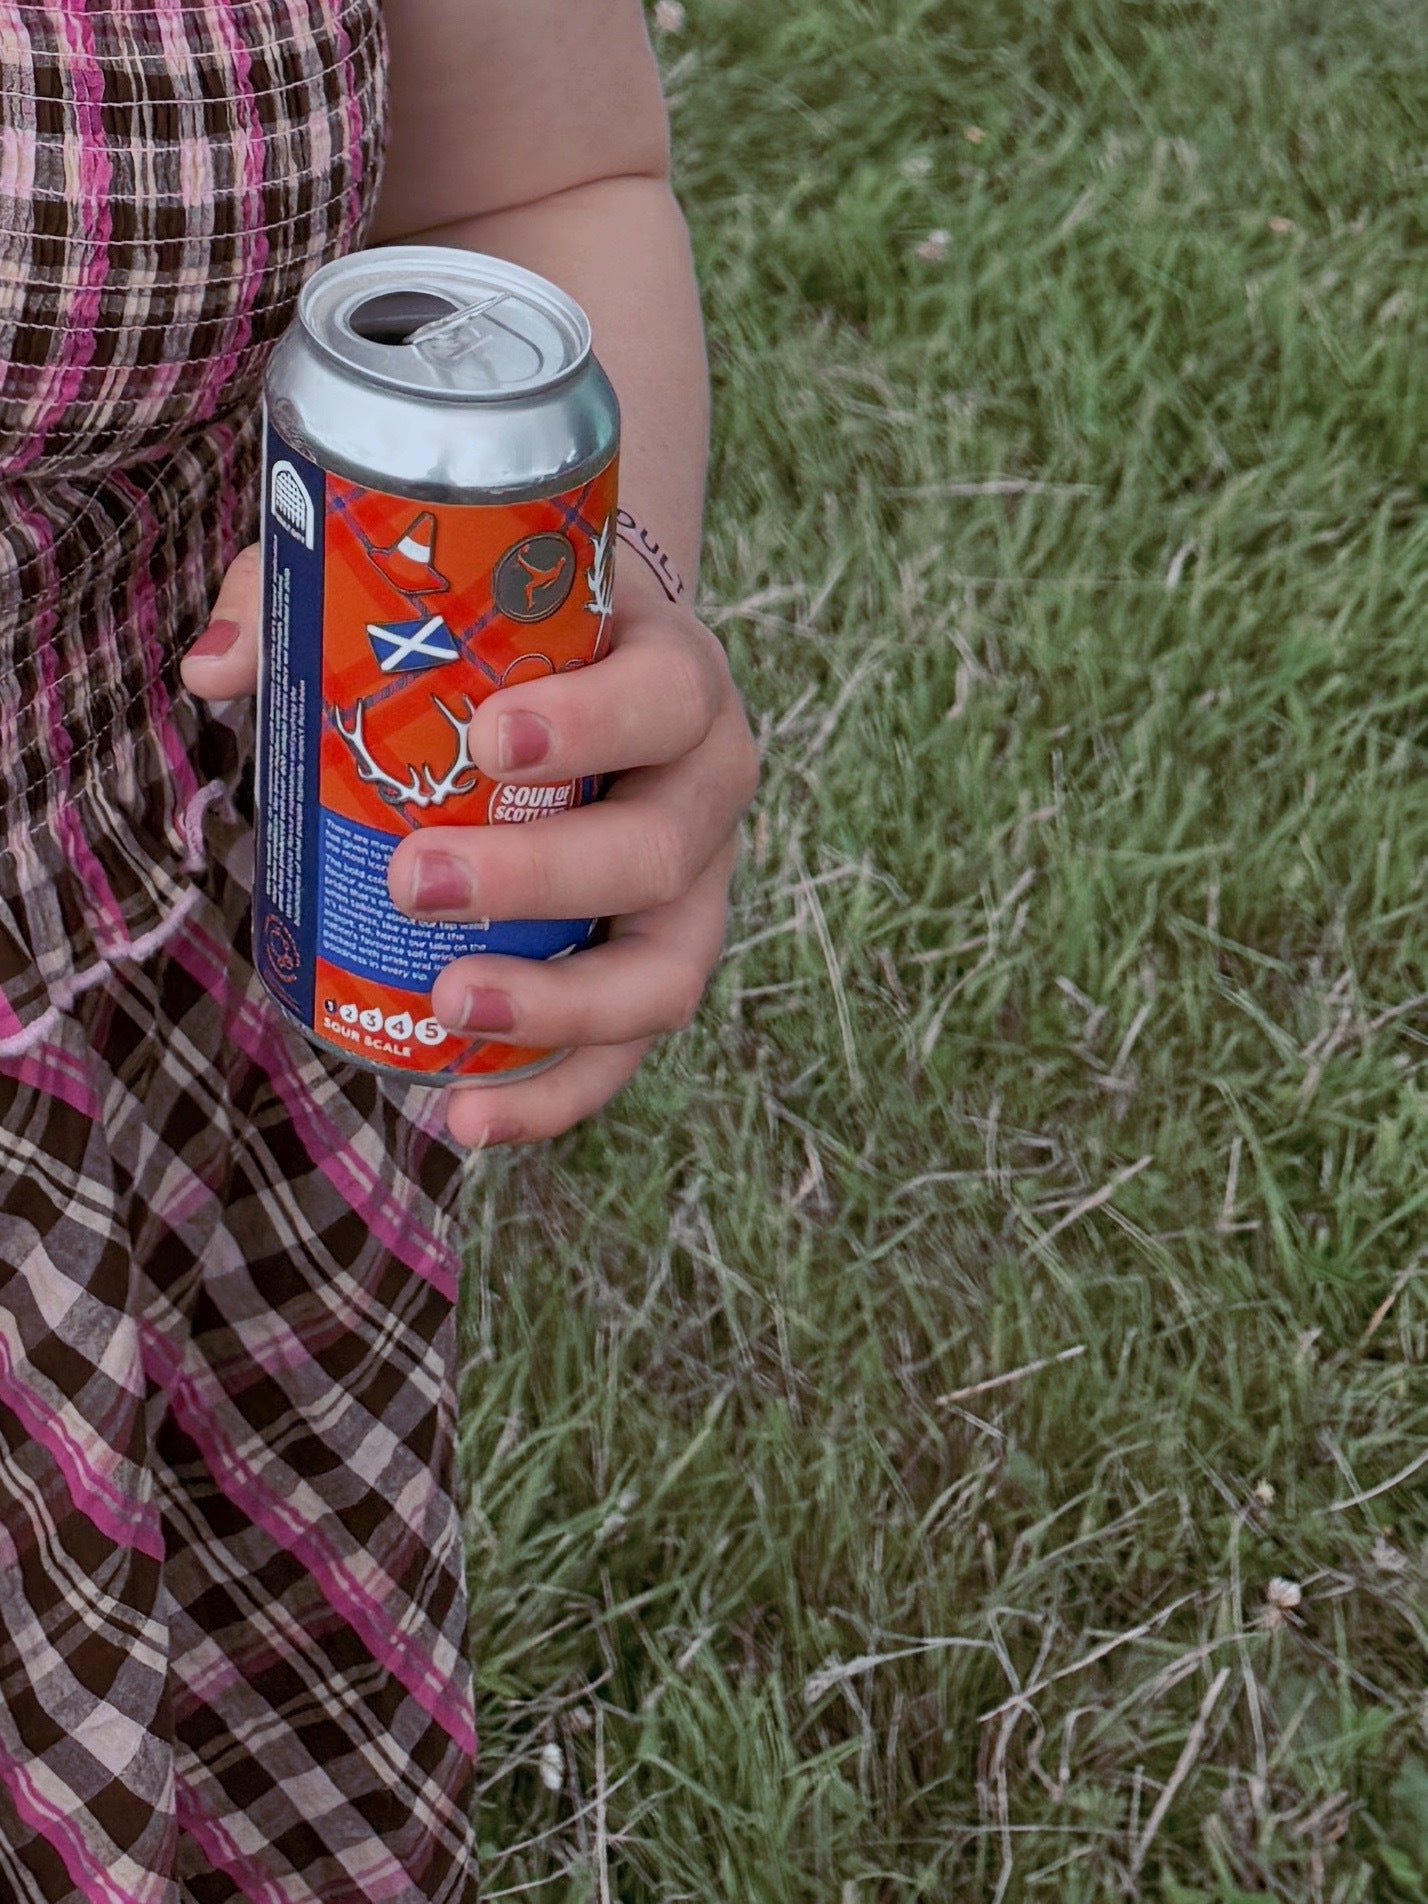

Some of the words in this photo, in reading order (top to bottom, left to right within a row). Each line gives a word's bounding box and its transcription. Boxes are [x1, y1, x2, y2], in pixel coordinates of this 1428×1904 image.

[500, 784, 556, 807] SOUR
[323, 1016, 361, 1043] SOUR
[363, 1035, 412, 1058] SCALE
[344, 1008, 353, 1020] 2
[366, 1012, 377, 1028] 3
[391, 1020, 406, 1035] 4
[425, 1022, 439, 1039] 5
